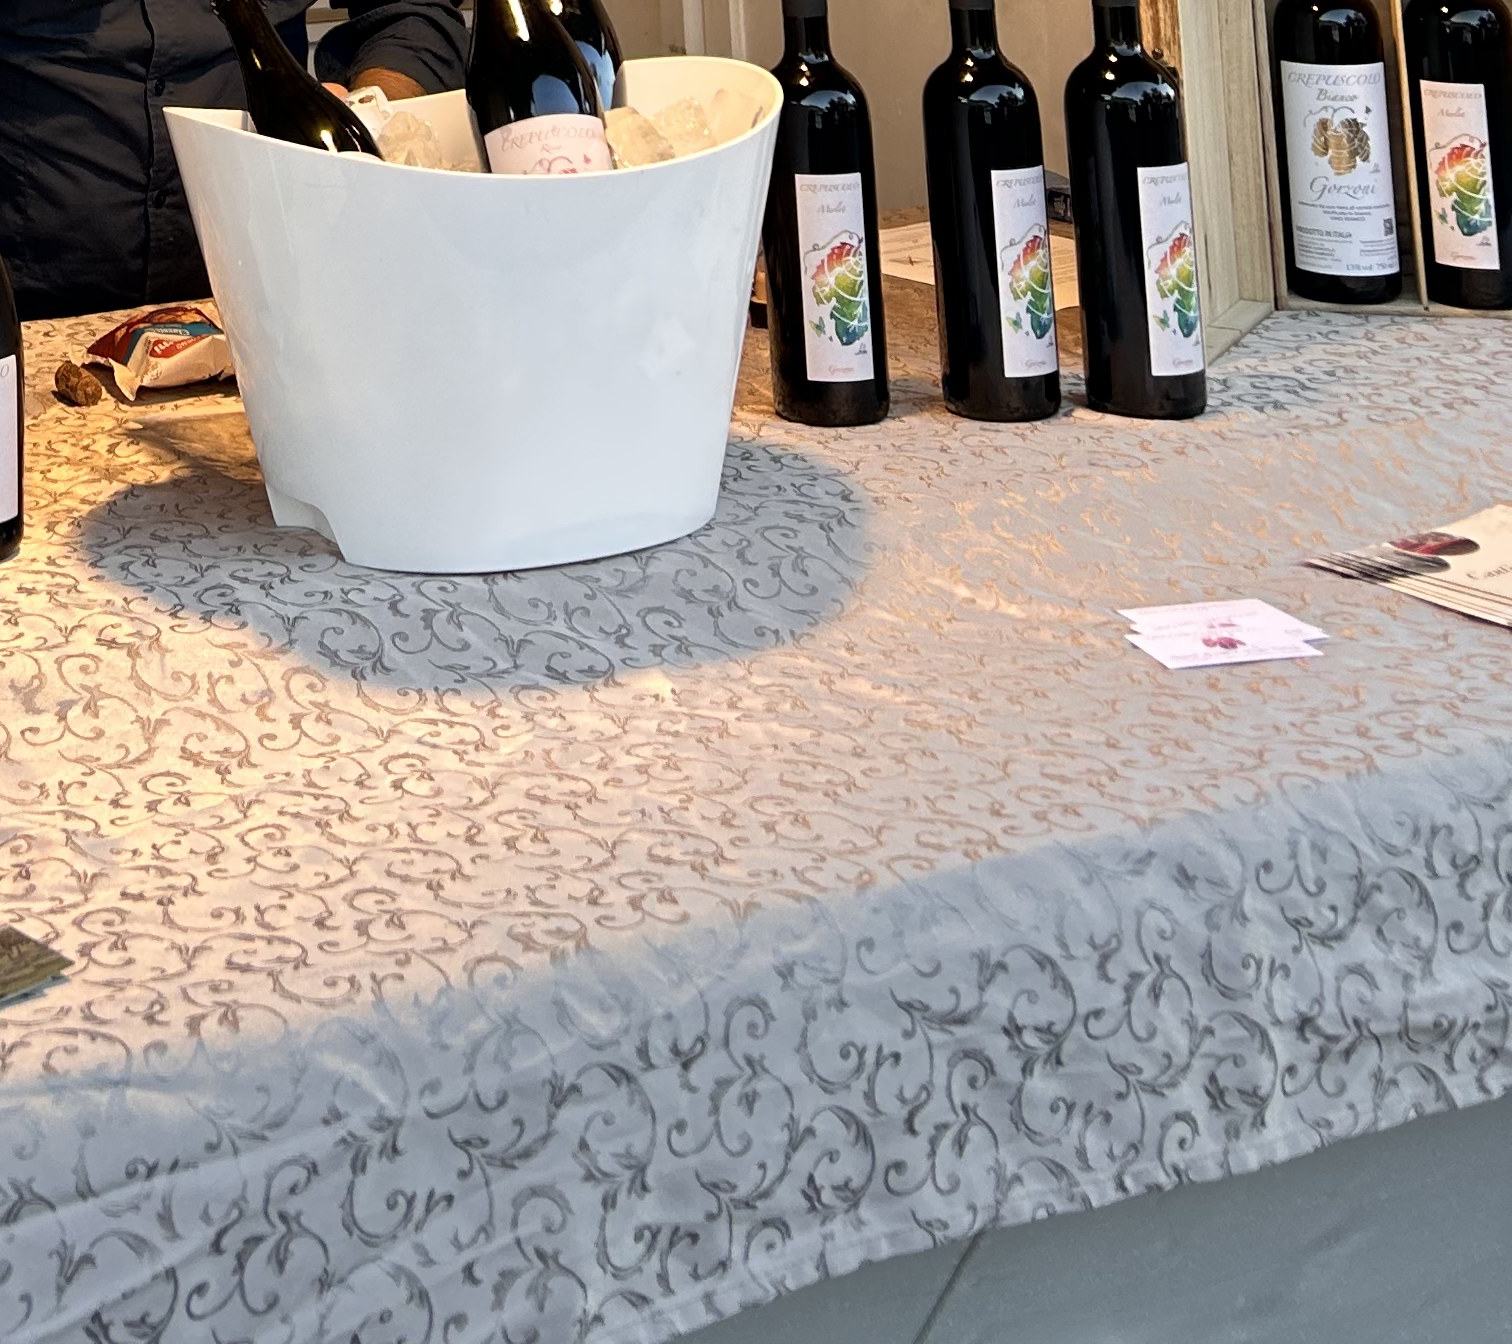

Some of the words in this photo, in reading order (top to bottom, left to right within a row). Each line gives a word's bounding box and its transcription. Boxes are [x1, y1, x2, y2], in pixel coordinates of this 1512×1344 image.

[1287, 71, 1381, 88] CREPUSCOLO
[1316, 88, 1359, 102] Bianco
[1309, 175, 1378, 202] Gorzoni
